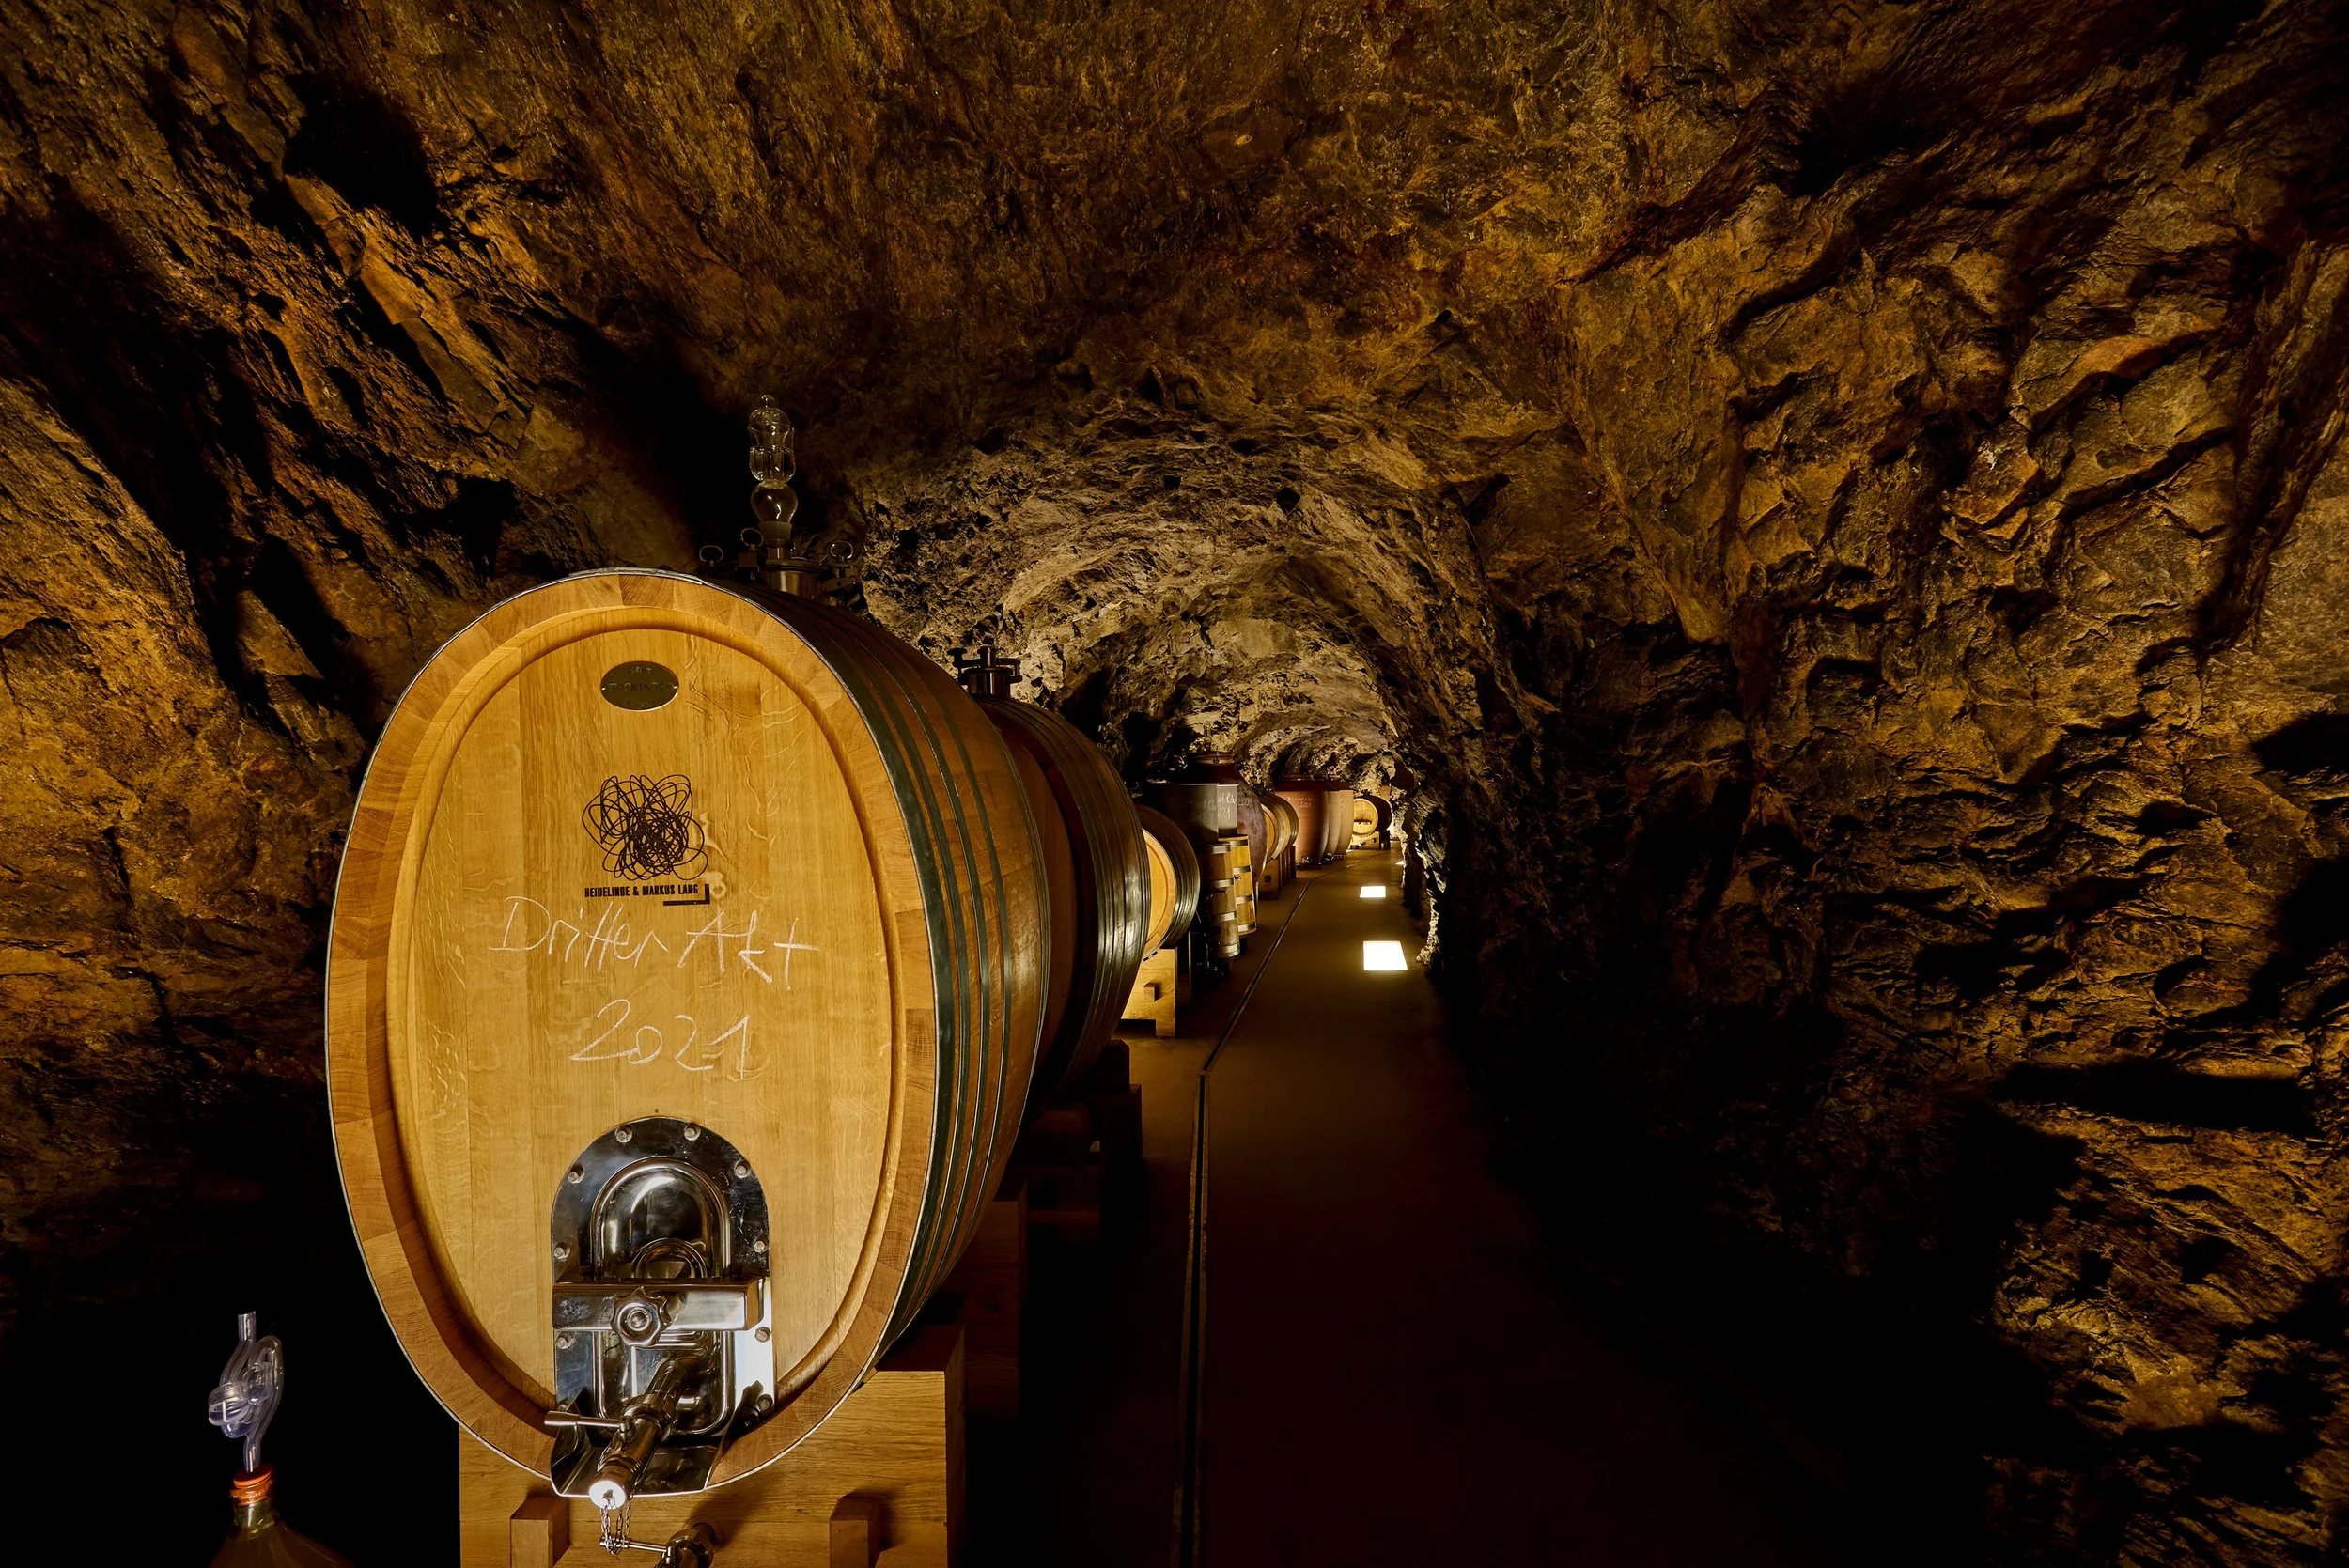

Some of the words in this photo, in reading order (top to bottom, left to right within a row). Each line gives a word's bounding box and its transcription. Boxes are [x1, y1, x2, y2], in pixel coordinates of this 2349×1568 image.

[584, 887, 630, 897] HEIDELINDE
[632, 886, 639, 895] &
[642, 885, 675, 895] MARKUS
[677, 884, 698, 894] LANG
[489, 895, 669, 971] Dritter
[677, 907, 821, 990] Akt
[568, 998, 751, 1080] 2021
